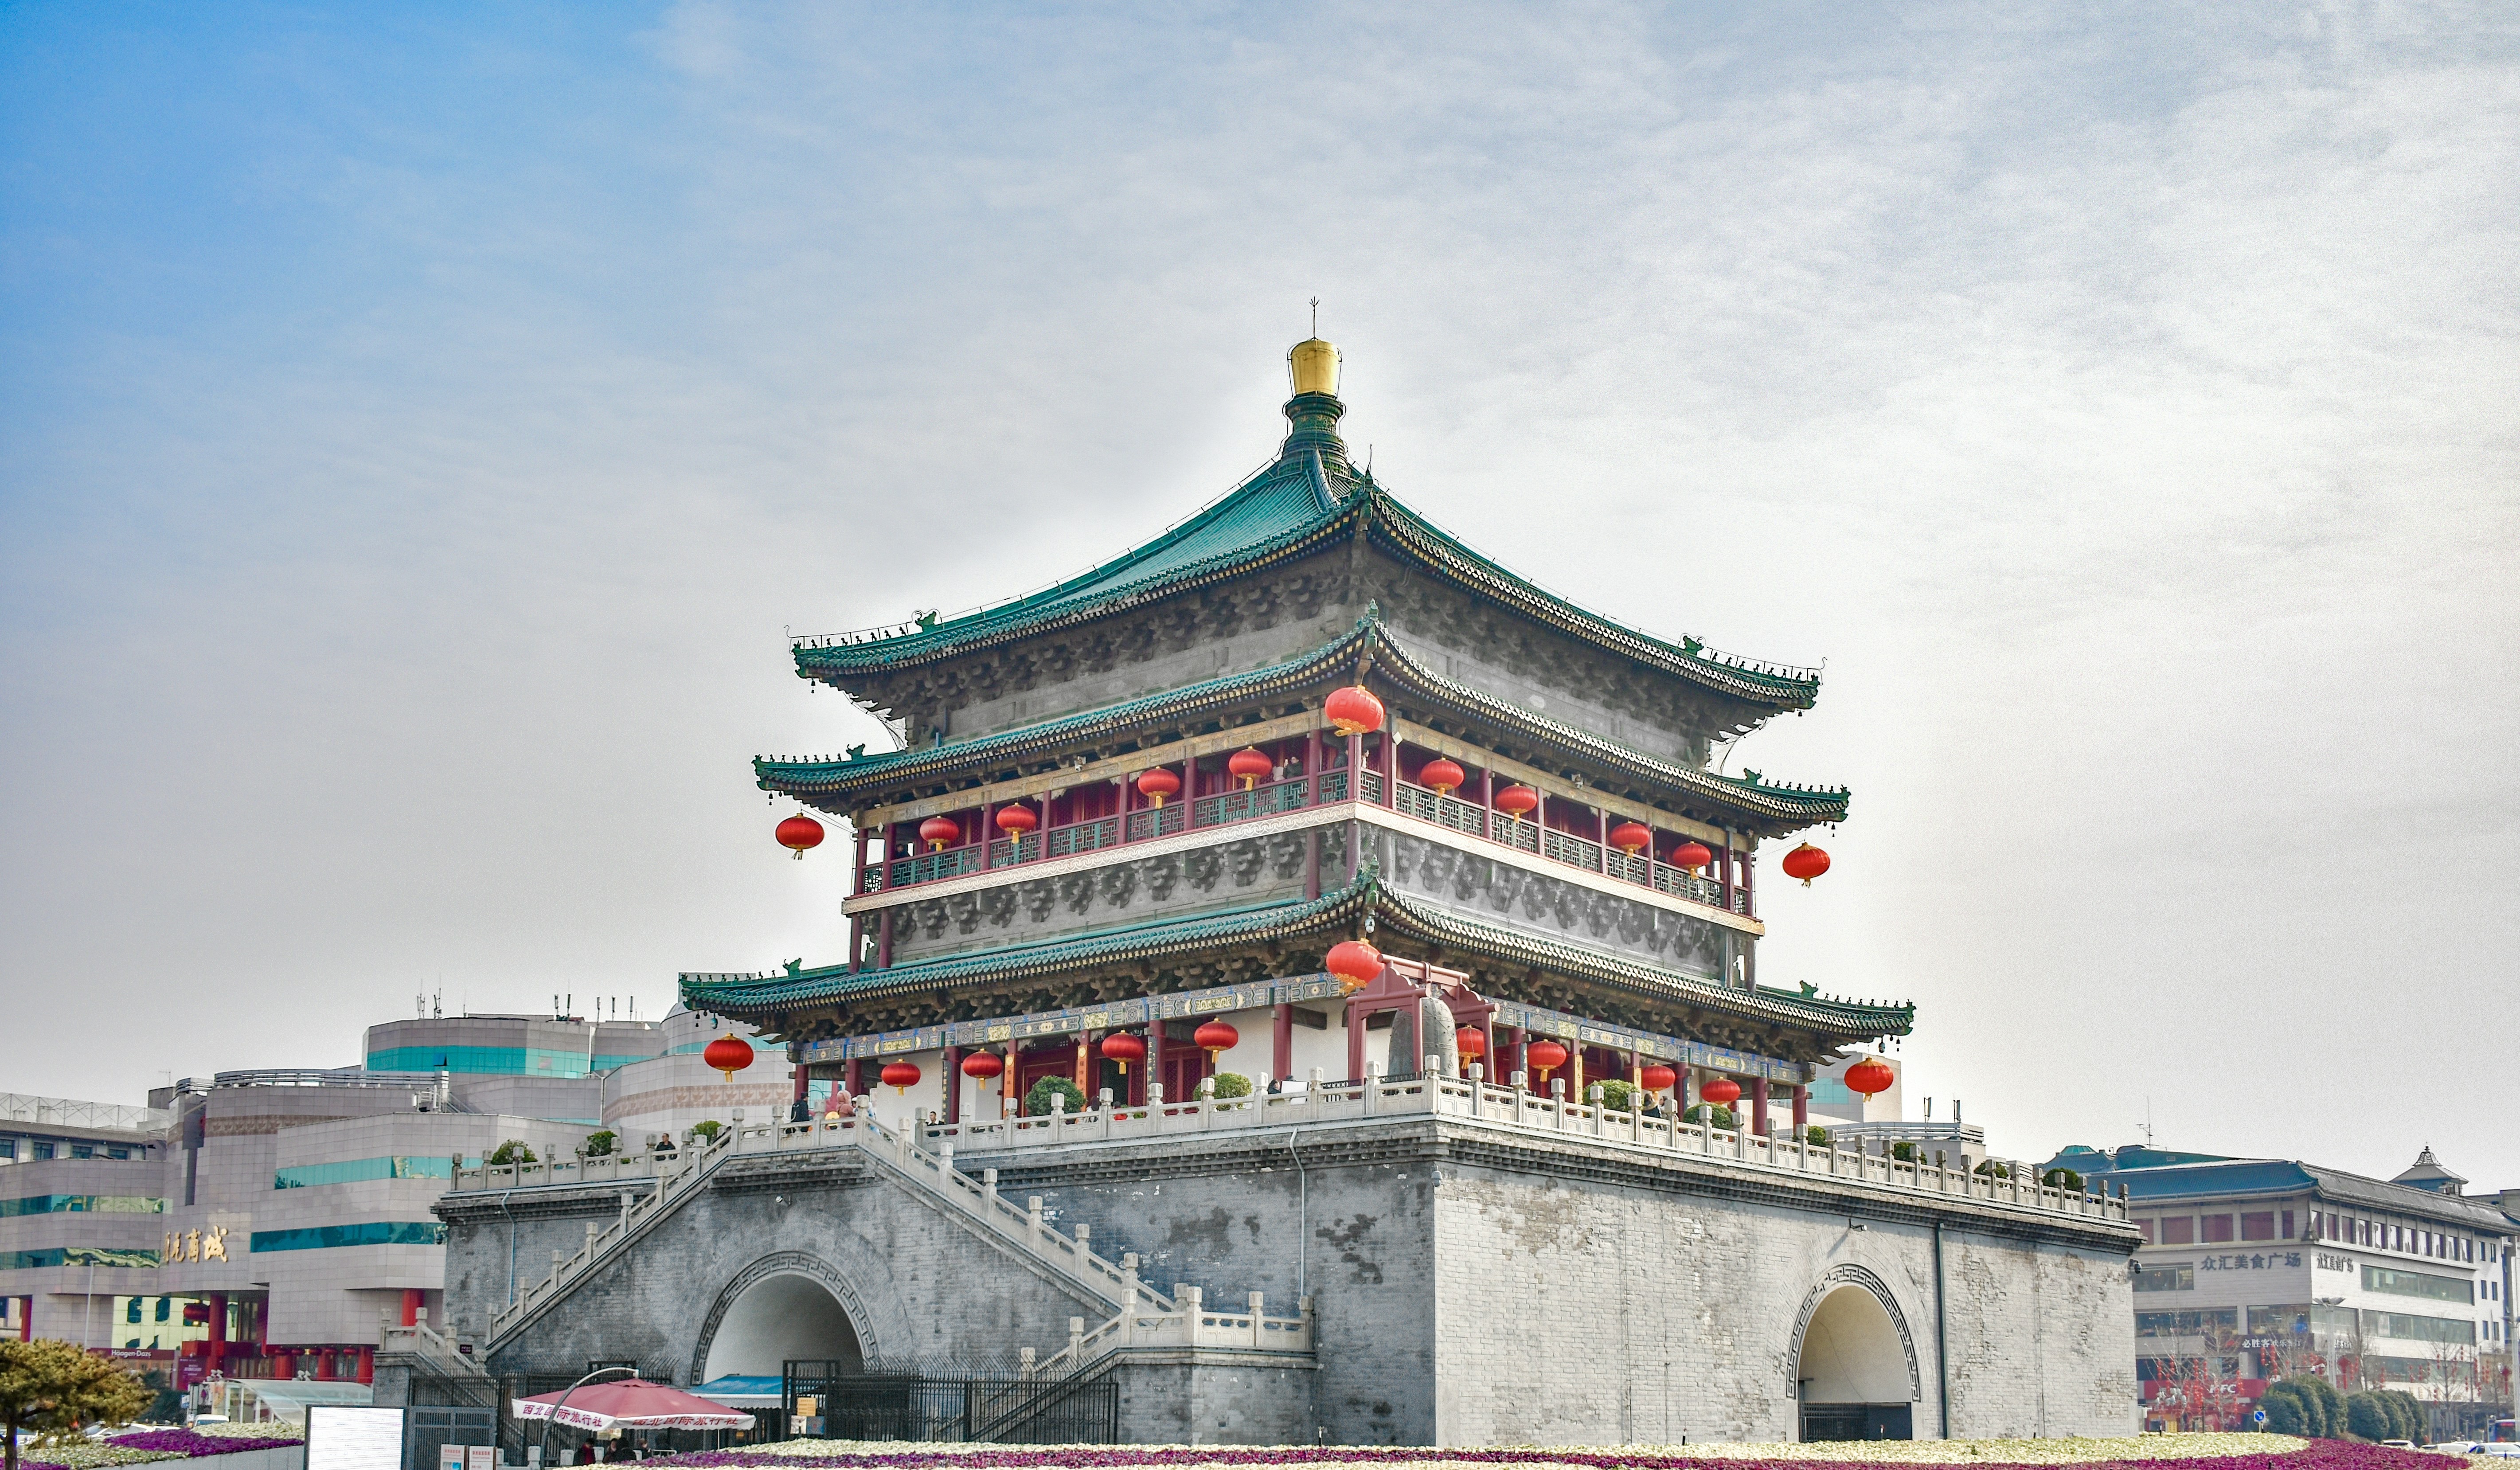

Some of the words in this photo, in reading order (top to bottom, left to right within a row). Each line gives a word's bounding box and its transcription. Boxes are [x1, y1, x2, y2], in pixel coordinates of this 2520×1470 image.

[164, 1225, 227, 1263] 元商城
[2200, 1252, 2301, 1271] 众汇美食广场
[523, 1404, 602, 1427] 西北国际旅行社
[632, 1416, 738, 1426] 西北国际旅行社
